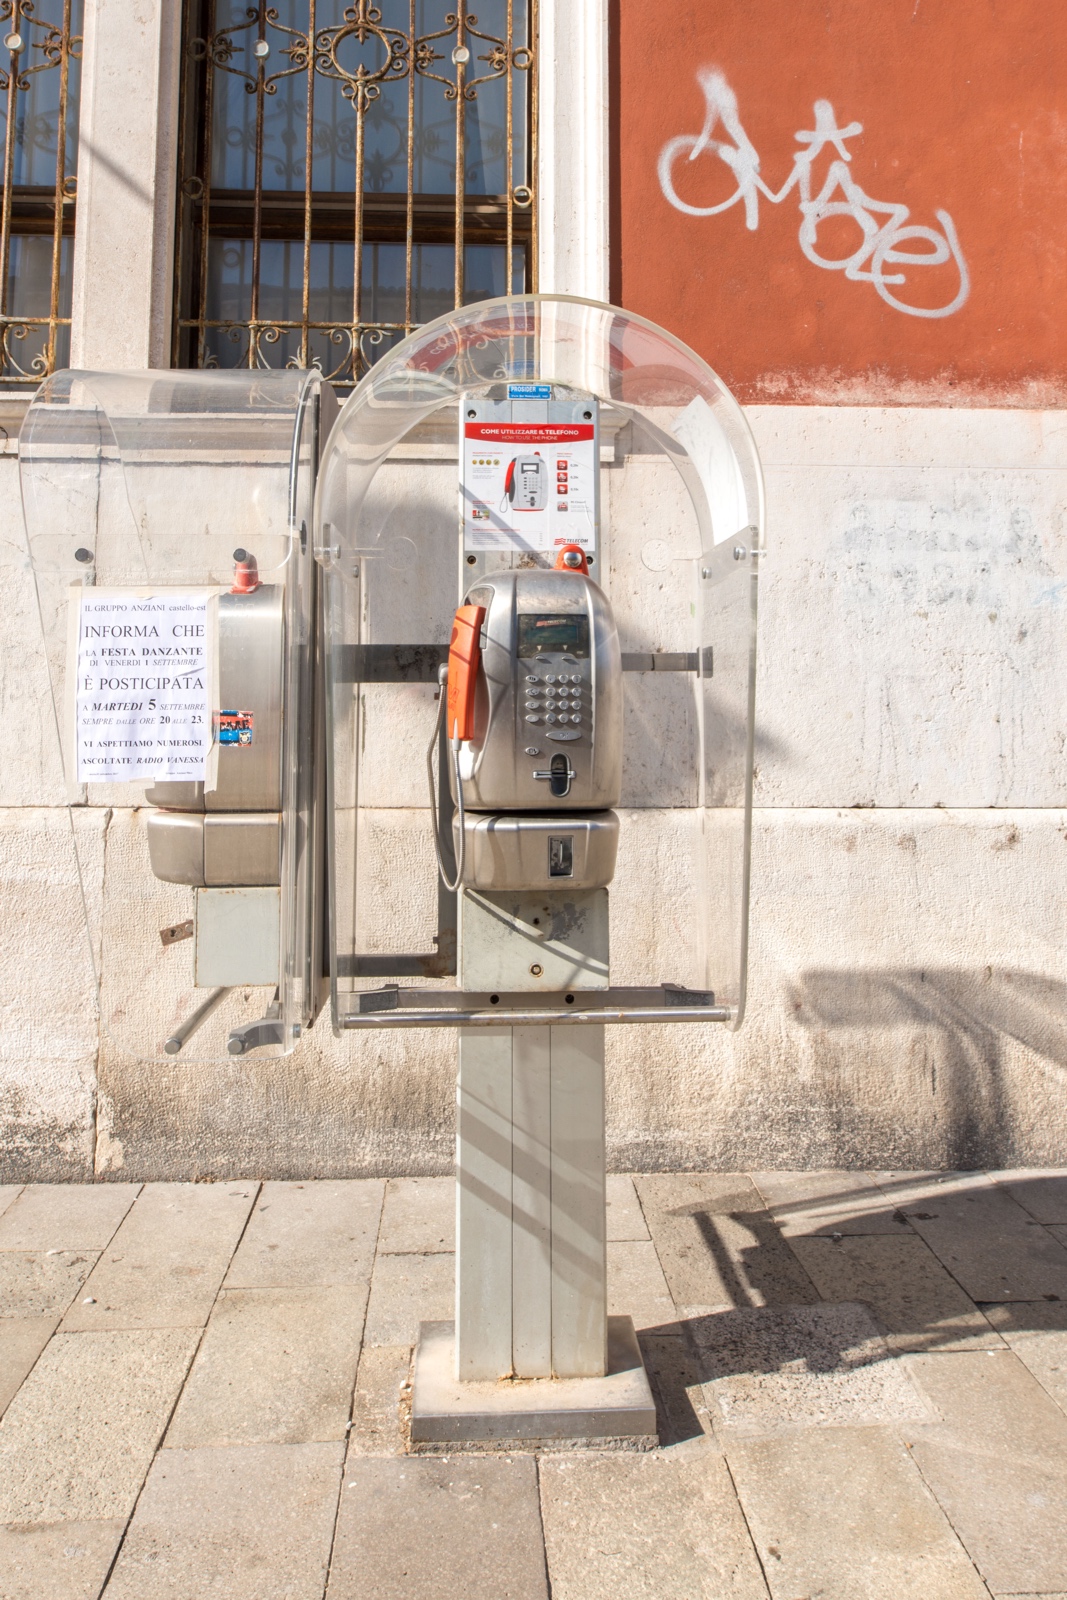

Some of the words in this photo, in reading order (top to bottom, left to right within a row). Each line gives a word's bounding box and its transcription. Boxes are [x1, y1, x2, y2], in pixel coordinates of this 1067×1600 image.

[85, 626, 159, 637] INFORMA
[173, 625, 205, 637] CHE
[101, 648, 136, 656] FESTA
[142, 648, 203, 656] DANZANTE
[84, 675, 93, 690] È
[99, 678, 204, 690] POSTICIPATA
[92, 703, 143, 711] MARTEDI
[148, 699, 156, 711] 5
[159, 716, 170, 724] 20
